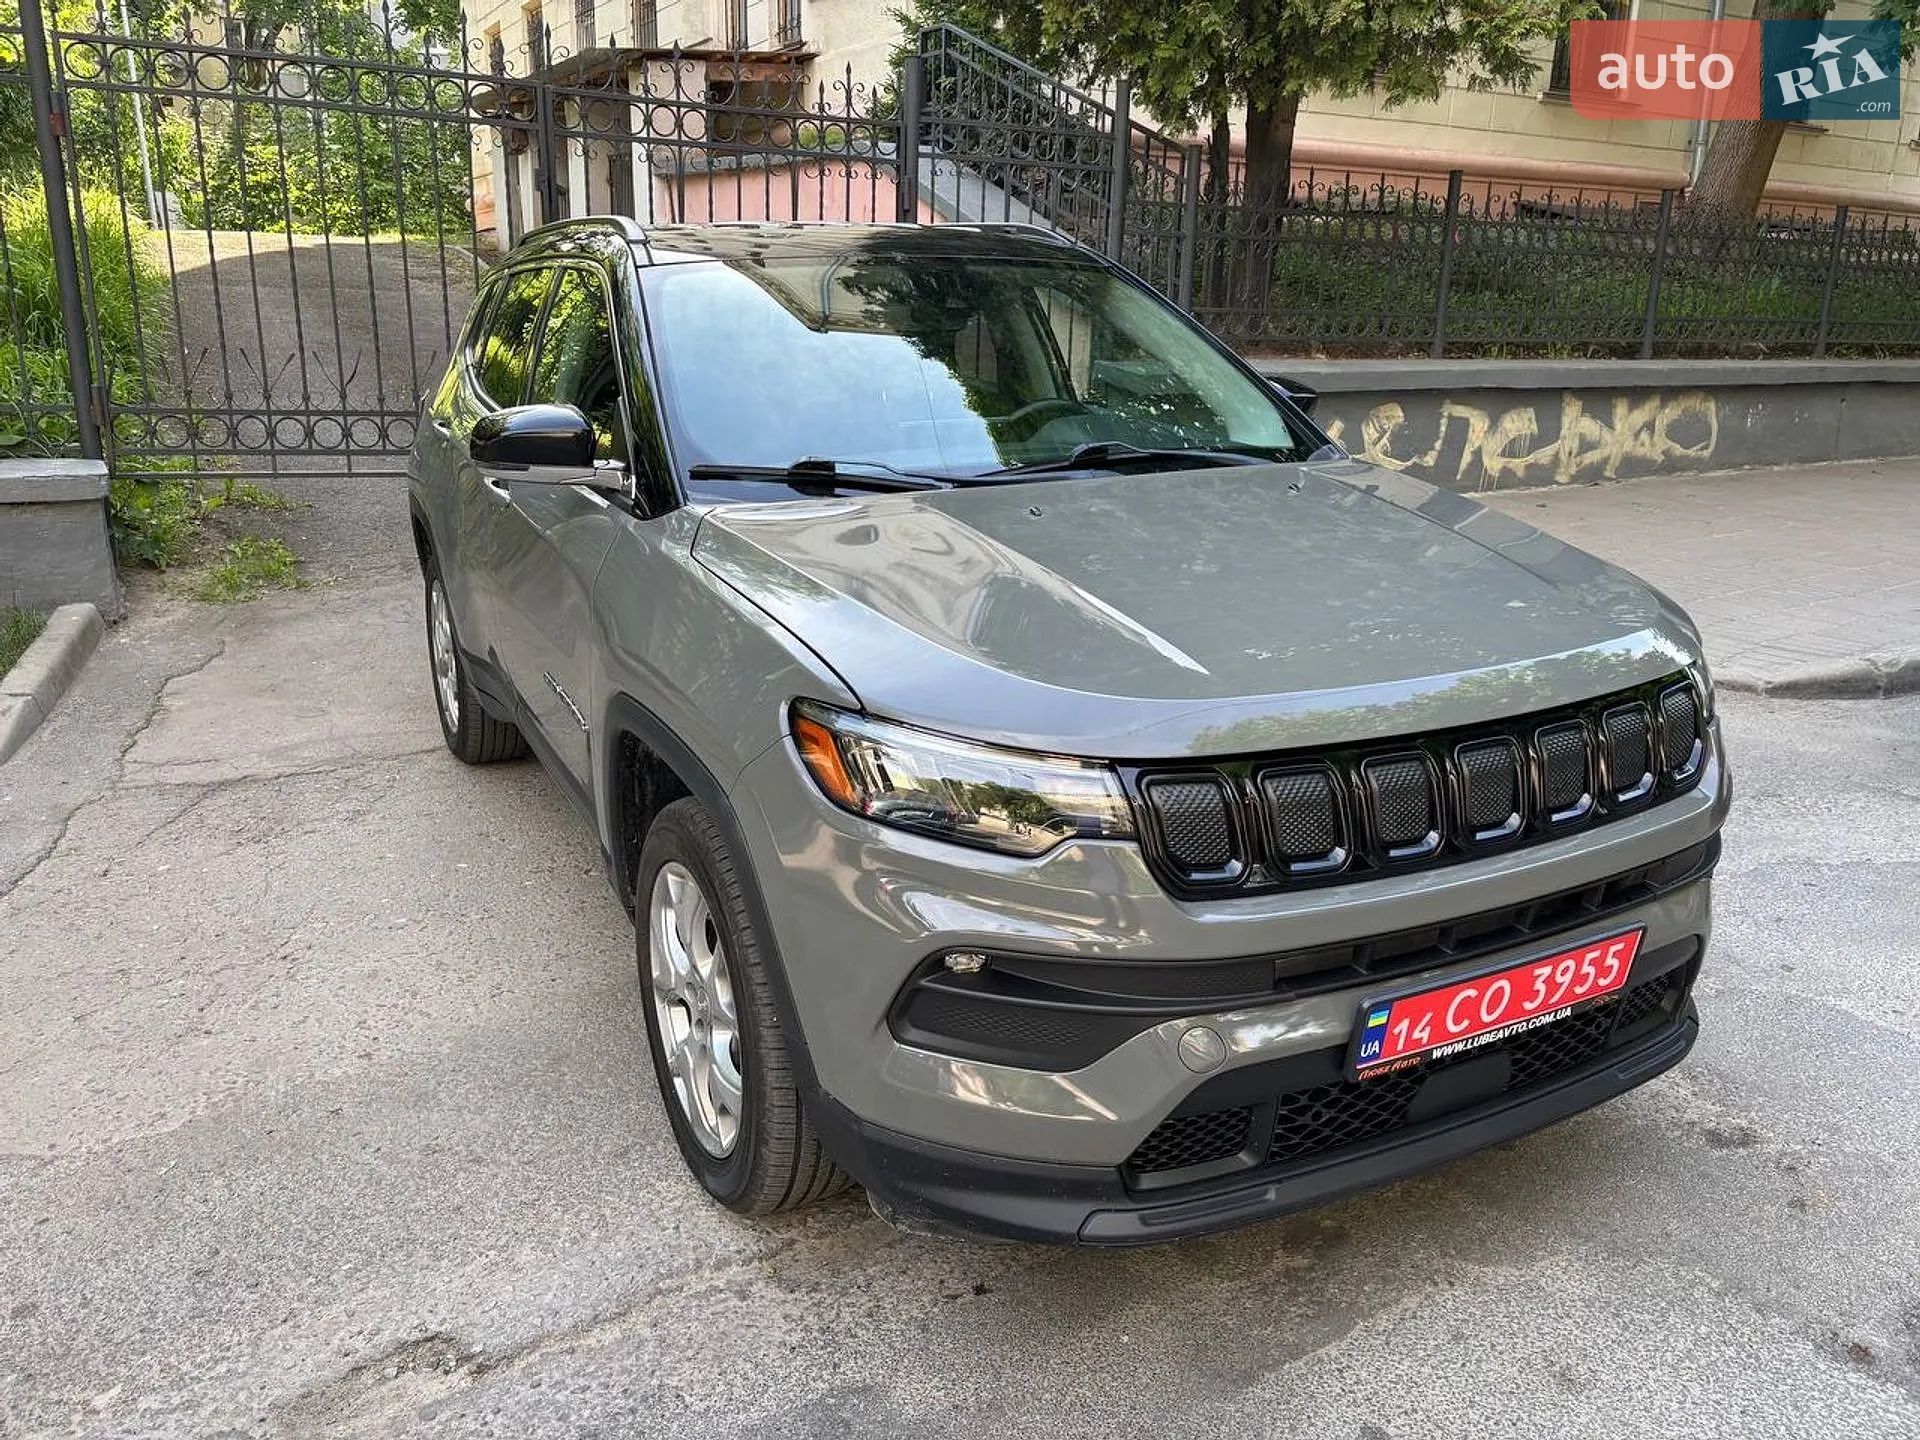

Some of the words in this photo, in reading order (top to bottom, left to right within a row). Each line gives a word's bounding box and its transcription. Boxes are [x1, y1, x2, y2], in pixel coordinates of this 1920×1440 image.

[1392, 1012, 1433, 1051] 14
[1446, 979, 1511, 1034] CO
[1522, 942, 1625, 1010] 3955
[1360, 1040, 1380, 1058] UA
[1432, 1007, 1572, 1059] WWW.LUBEAVTO.COM.UA
